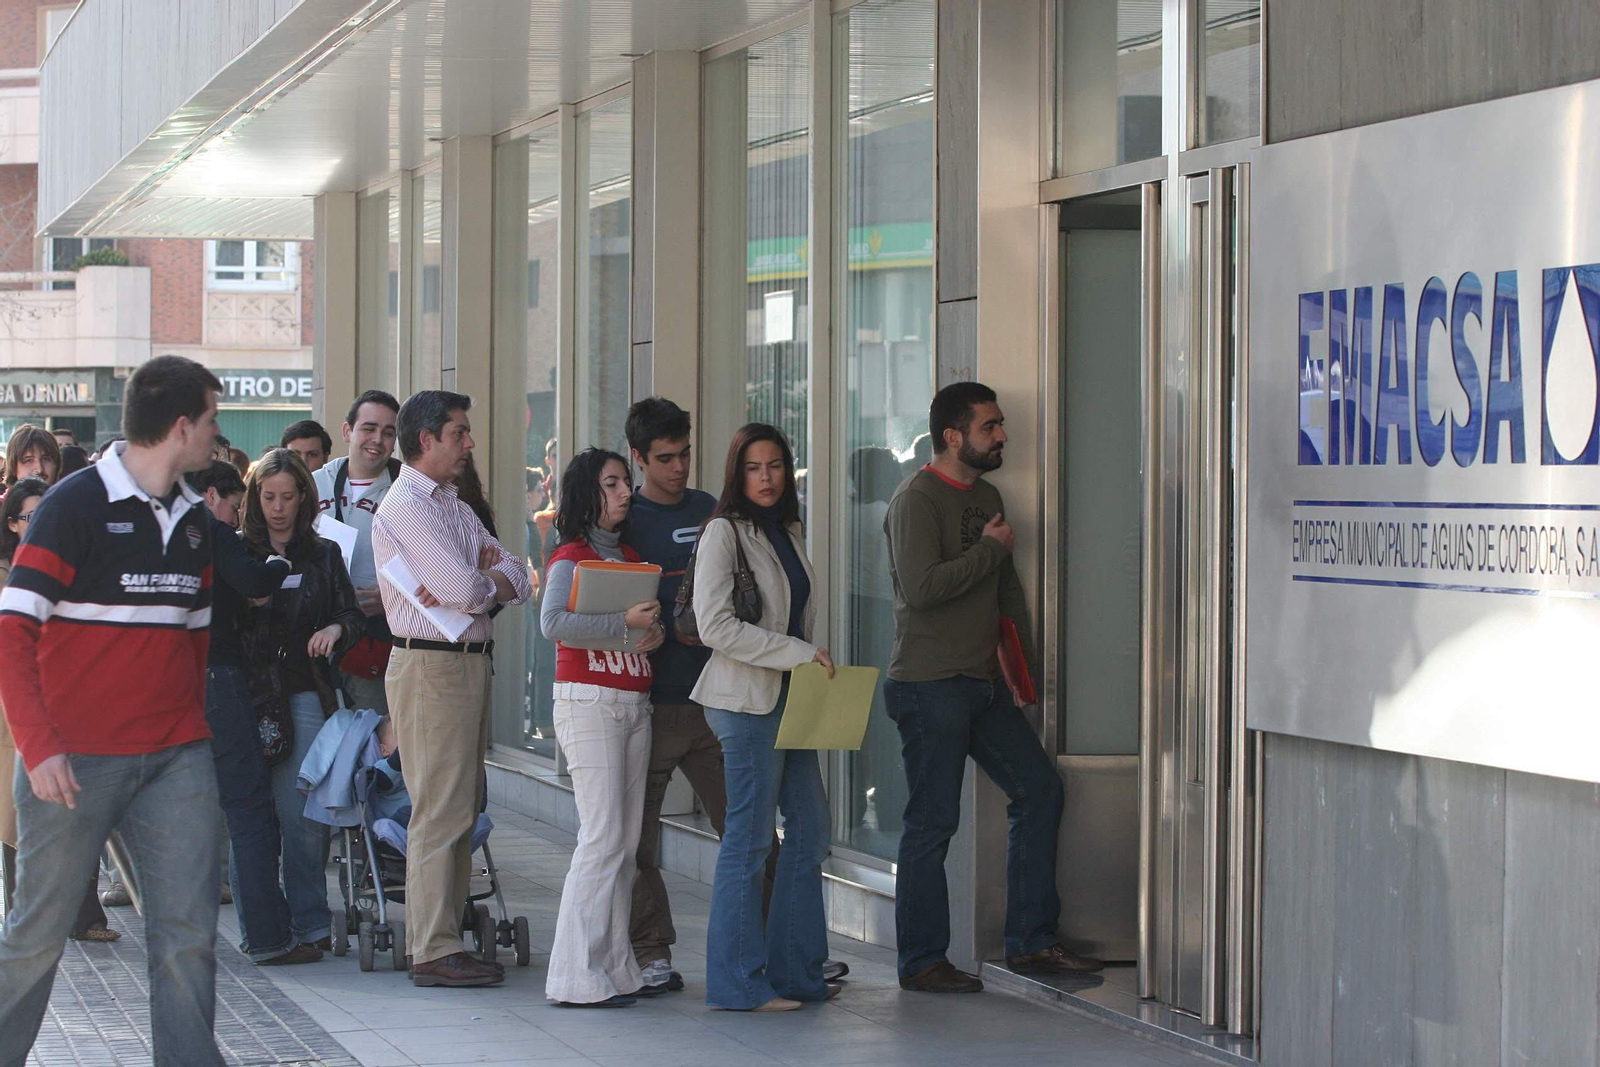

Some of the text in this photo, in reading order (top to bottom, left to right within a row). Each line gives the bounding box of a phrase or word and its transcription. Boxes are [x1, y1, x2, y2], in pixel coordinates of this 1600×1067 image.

[1298, 270, 1526, 467] EMACSA
[23, 382, 89, 403] DENTAL
[219, 376, 312, 397] TRO DE
[1293, 520, 1345, 565] EMPRESA
[1347, 521, 1409, 568] MUNICIPAL
[1412, 523, 1428, 569] DE
[1430, 523, 1474, 571] AGUAS
[1478, 524, 1495, 572] DE
[1499, 524, 1571, 584] CORDOBA,
[120, 573, 149, 586] SAN
